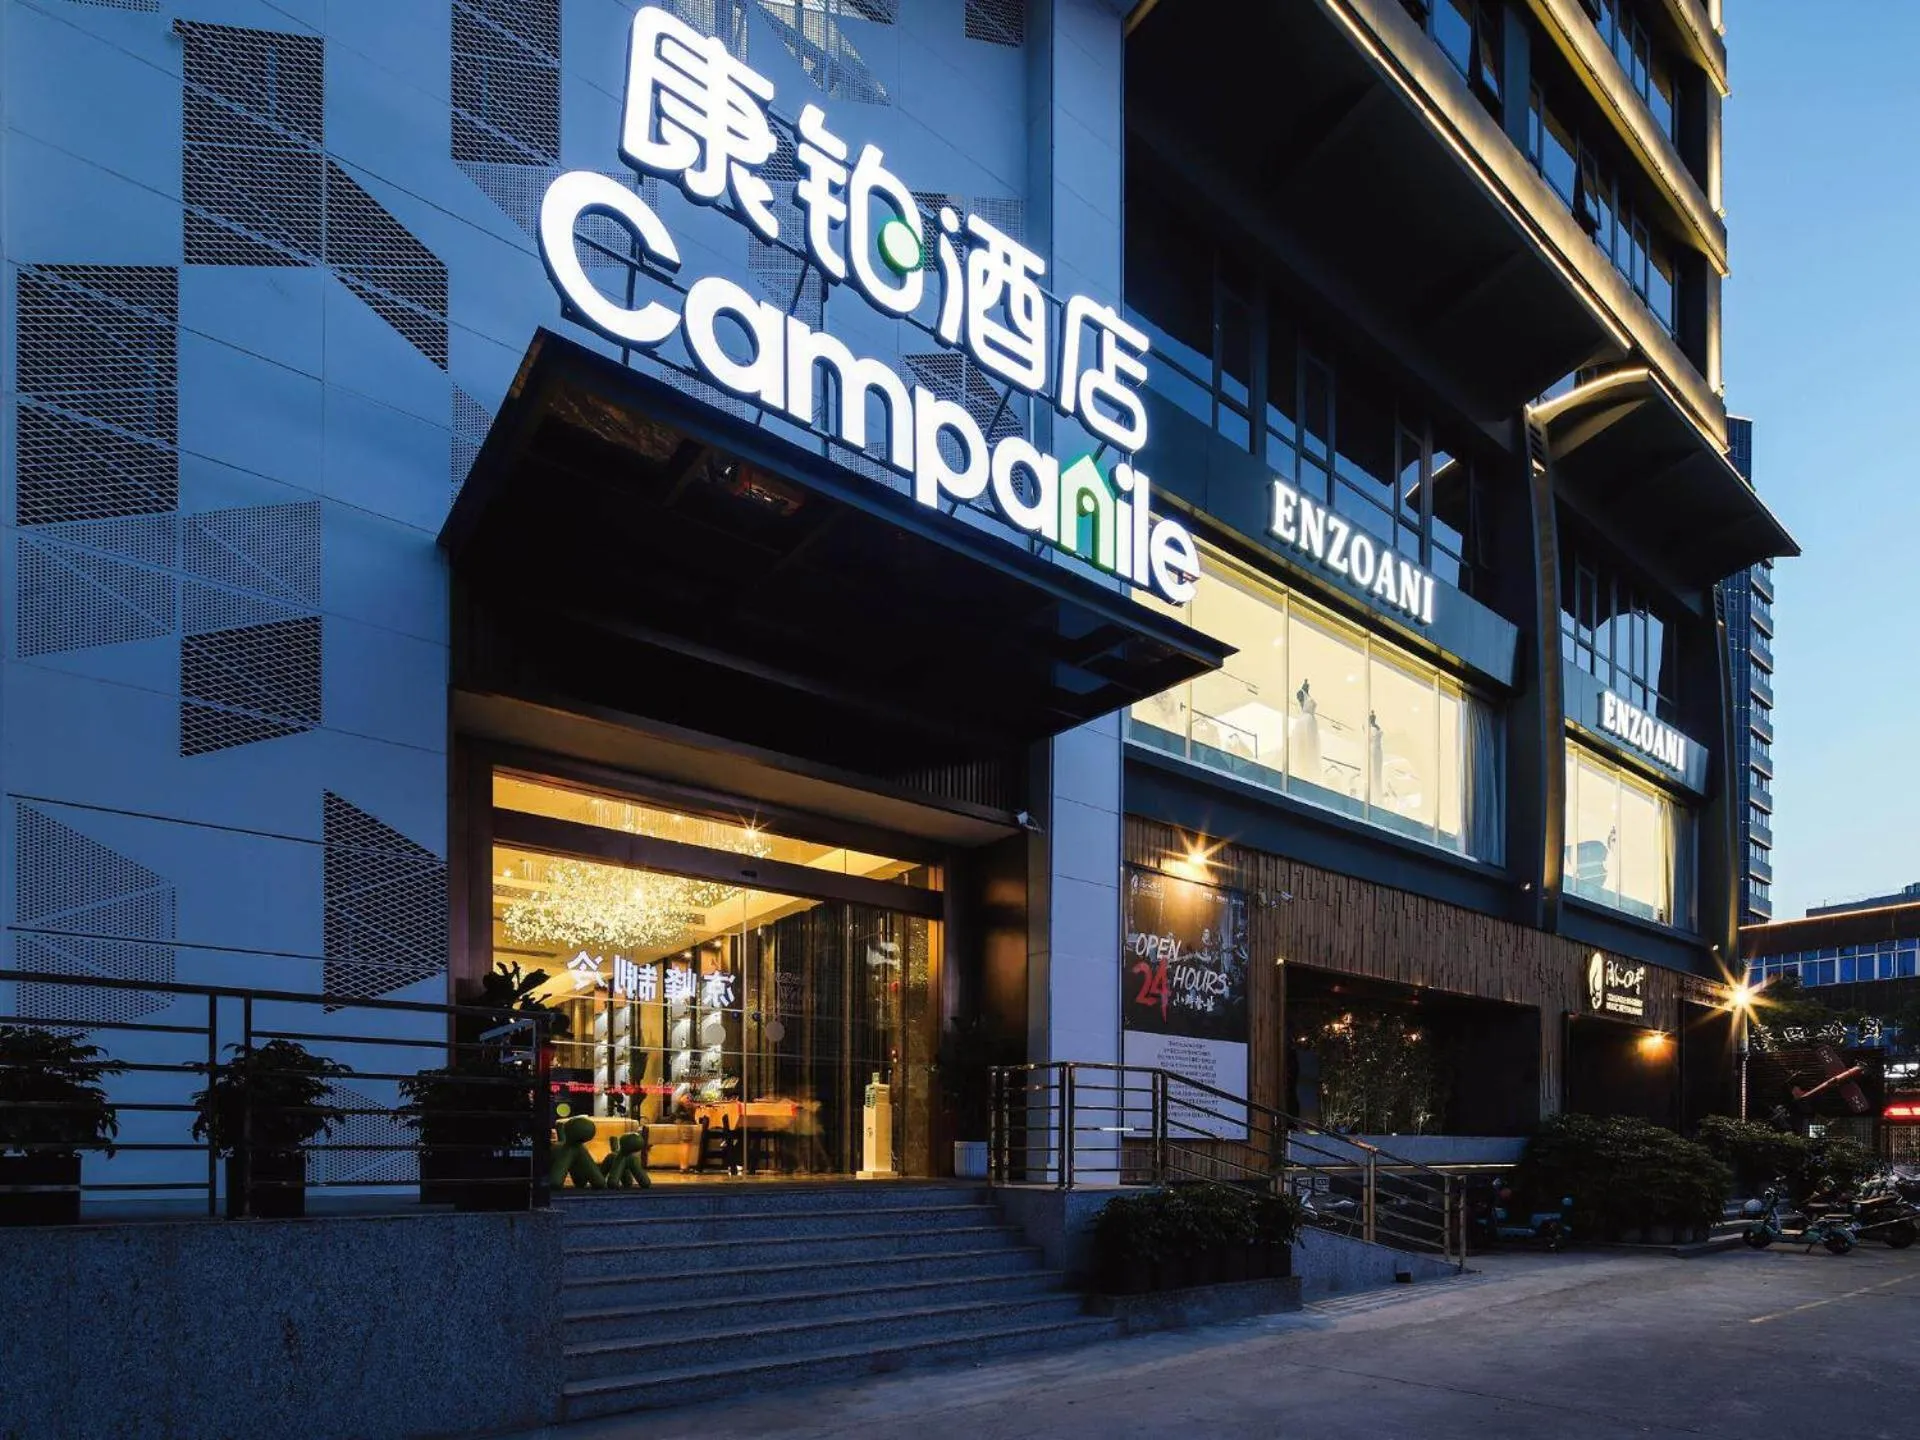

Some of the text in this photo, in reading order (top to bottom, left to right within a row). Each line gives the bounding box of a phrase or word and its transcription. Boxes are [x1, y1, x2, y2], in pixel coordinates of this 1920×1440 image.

[620, 5, 1150, 453] 康铂酒店
[540, 170, 1201, 605] Campanile
[1272, 479, 1434, 624] ENZOANI
[1603, 690, 1685, 771] ENZOANI
[1132, 956, 1228, 1024] 24 HOURS
[1136, 933, 1181, 960] OPEN
